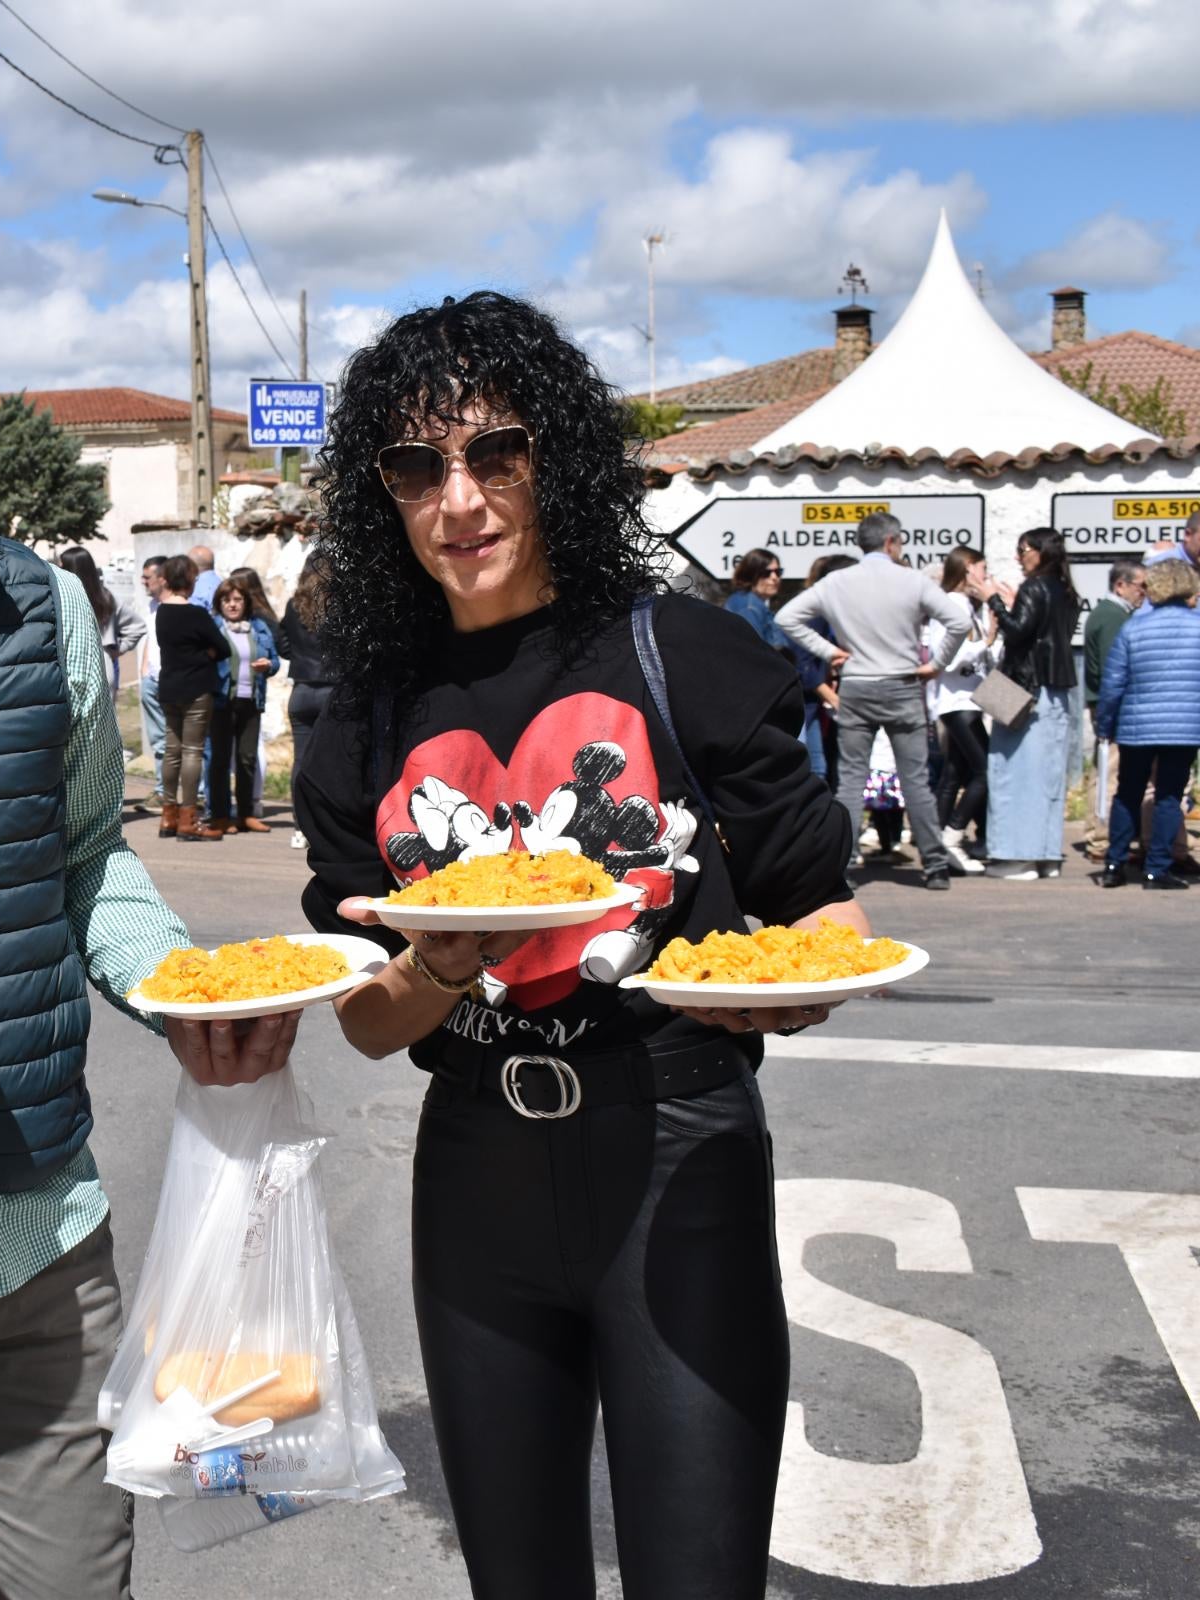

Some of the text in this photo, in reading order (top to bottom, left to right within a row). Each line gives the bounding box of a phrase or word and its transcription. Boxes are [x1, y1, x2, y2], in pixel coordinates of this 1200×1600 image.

[260, 409, 316, 425] VENDE
[254, 428, 276, 442] 649
[278, 428, 301, 442] 900
[722, 531, 735, 547] 2
[1061, 526, 1186, 544] FORFOLED
[443, 1000, 514, 1044] ICKEY
